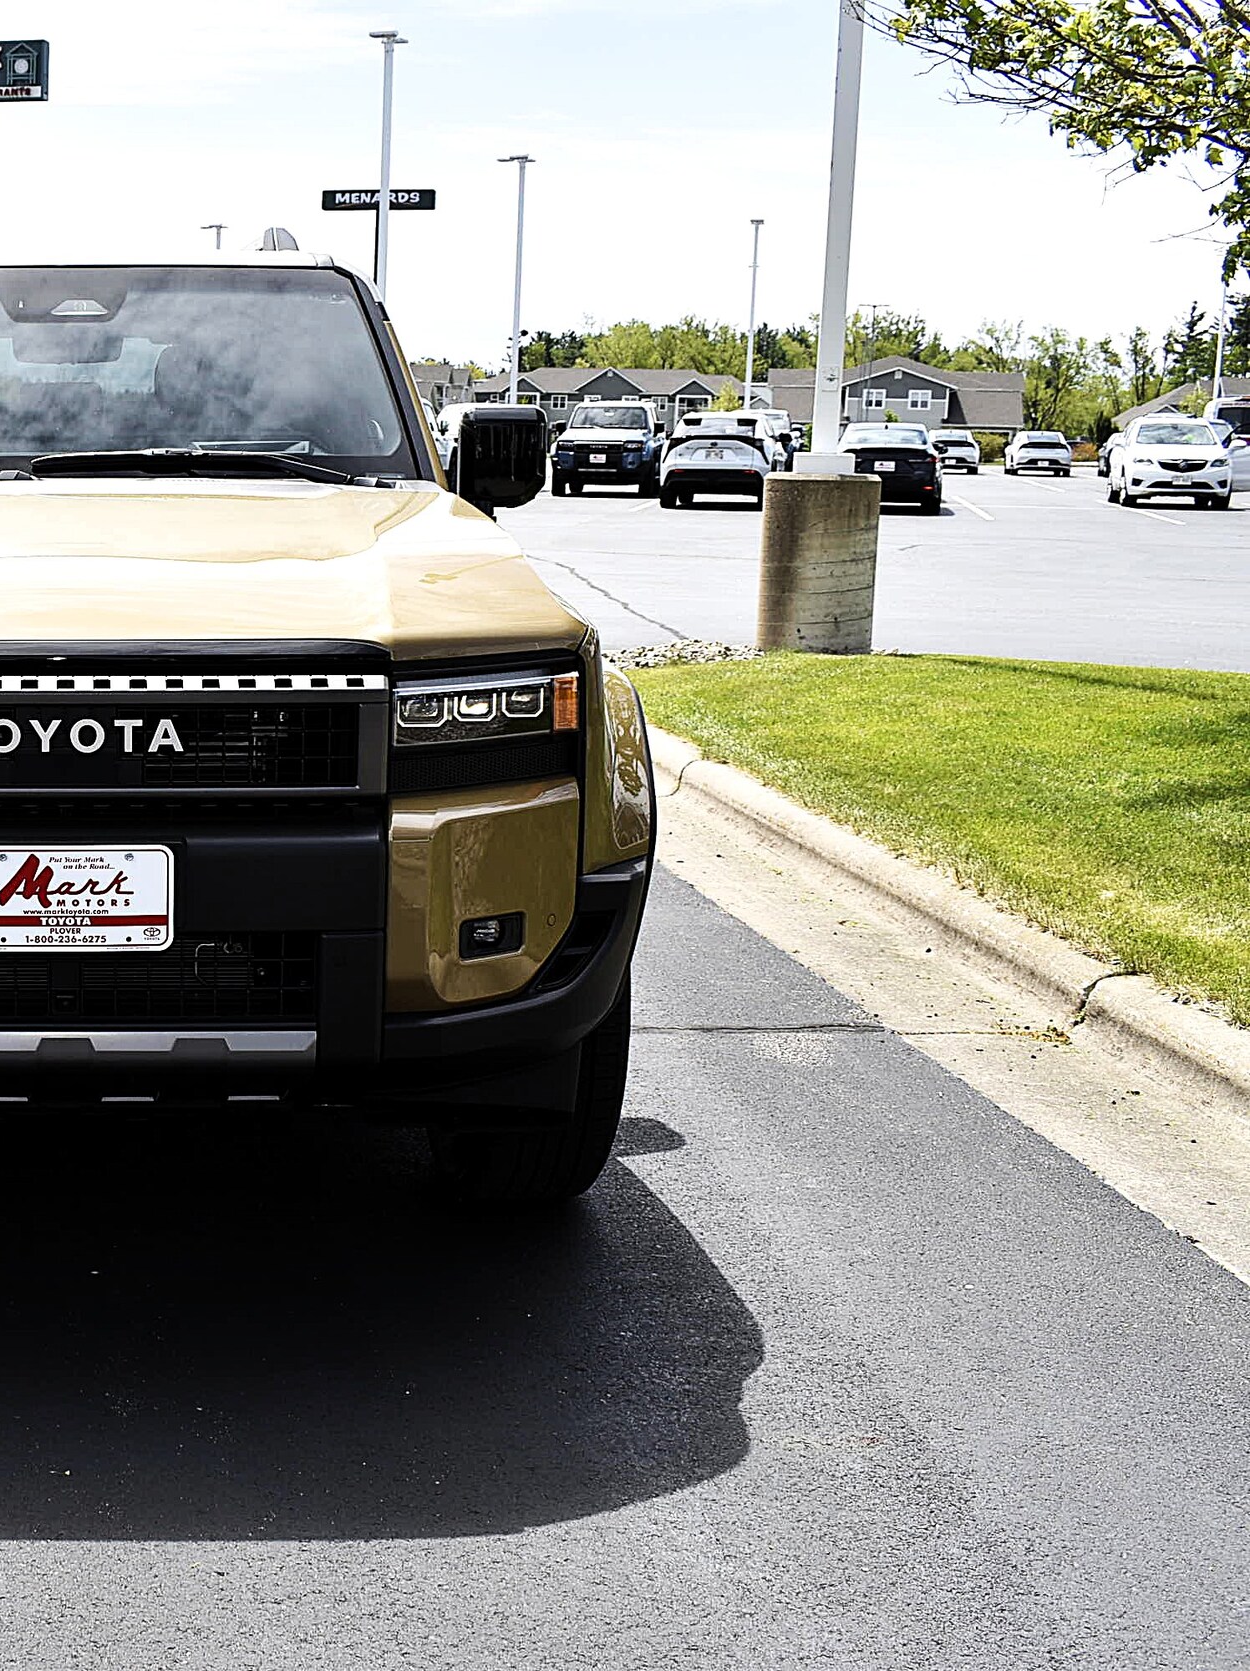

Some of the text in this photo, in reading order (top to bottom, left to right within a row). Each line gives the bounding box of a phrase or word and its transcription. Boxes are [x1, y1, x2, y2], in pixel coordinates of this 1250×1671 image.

[56, 898, 131, 907] MOTORS
[22, 908, 109, 916] www.marktoyota.com
[40, 917, 91, 926] TOYOTA
[25, 935, 107, 943] 1-800-236-6275
